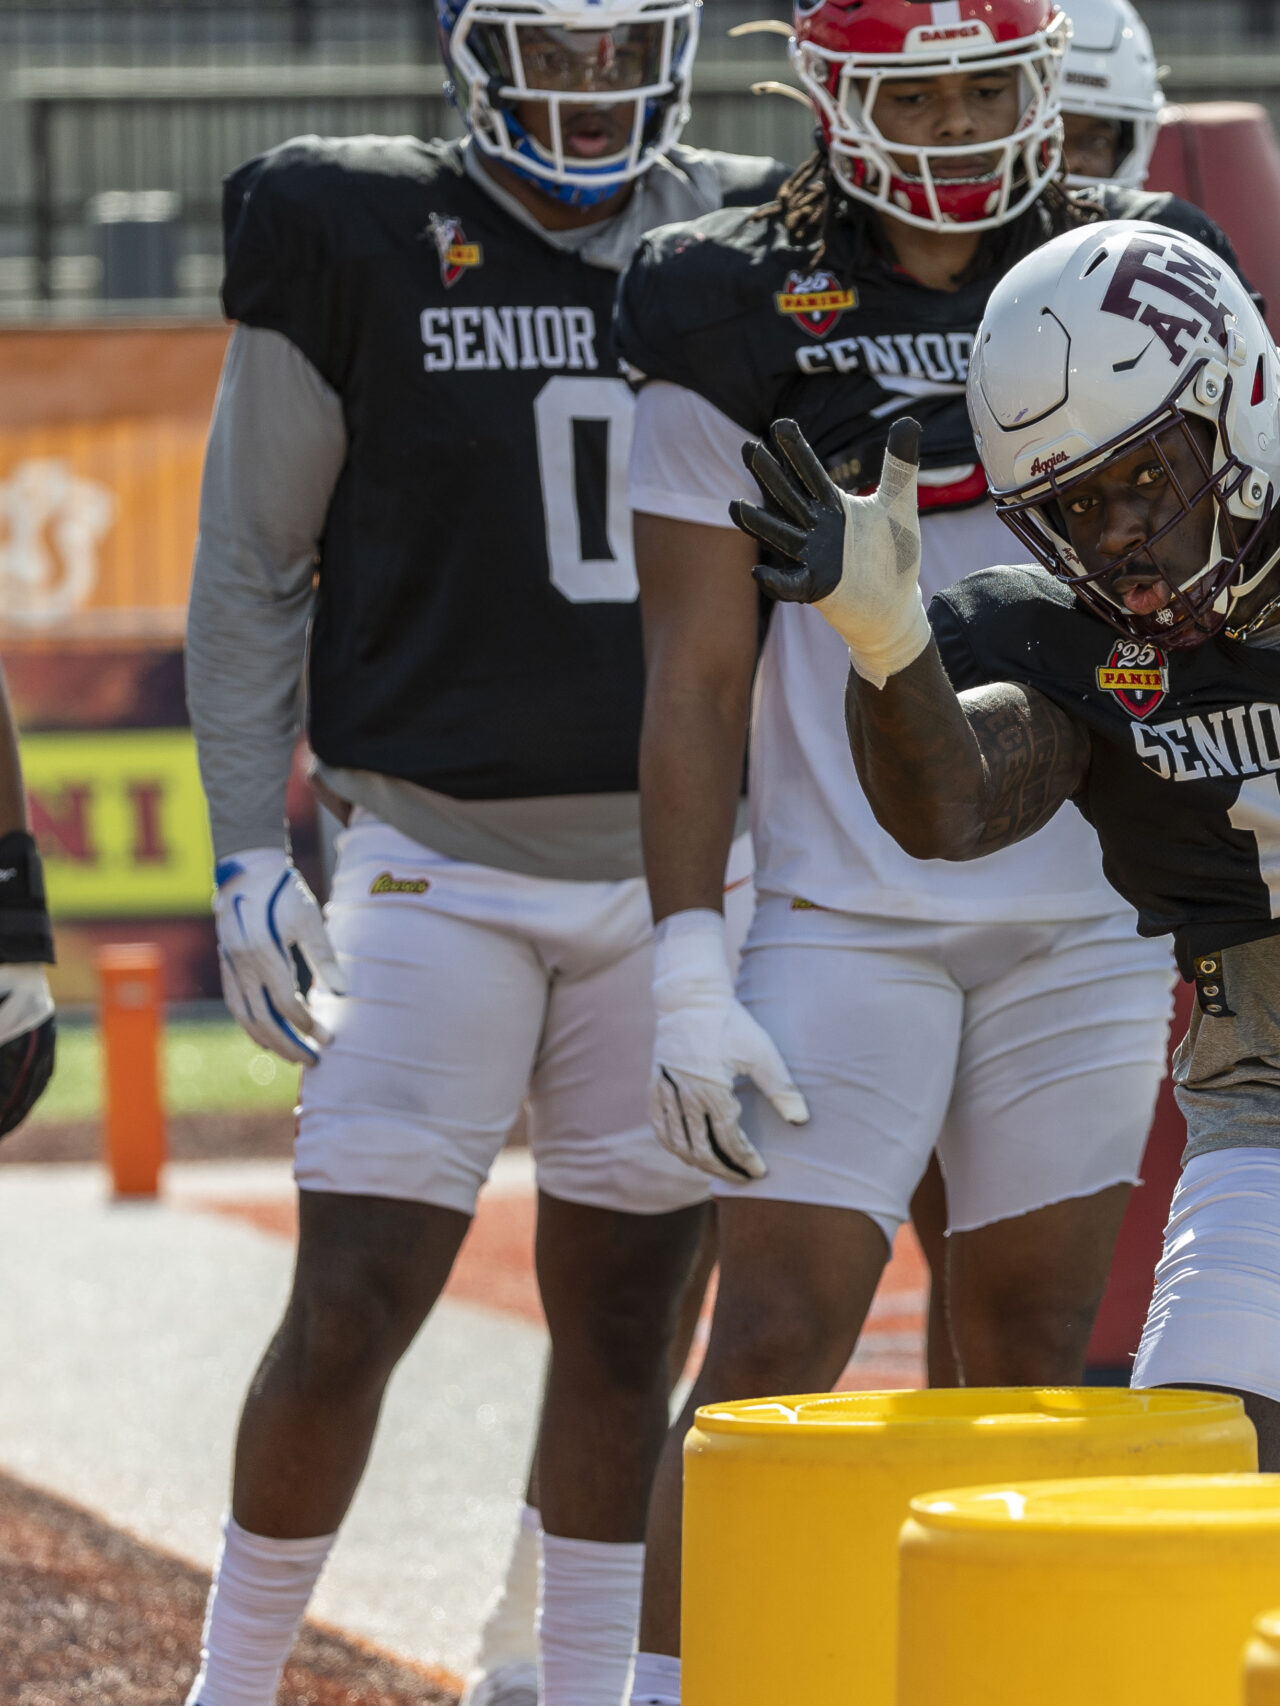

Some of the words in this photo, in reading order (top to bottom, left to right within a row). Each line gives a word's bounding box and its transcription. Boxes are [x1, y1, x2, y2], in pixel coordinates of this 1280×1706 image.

[919, 25, 980, 42] DAWGS
[420, 306, 598, 373] SENIOR
[1030, 450, 1070, 477] Aggies
[533, 375, 640, 603] 0
[1116, 642, 1156, 668] '25
